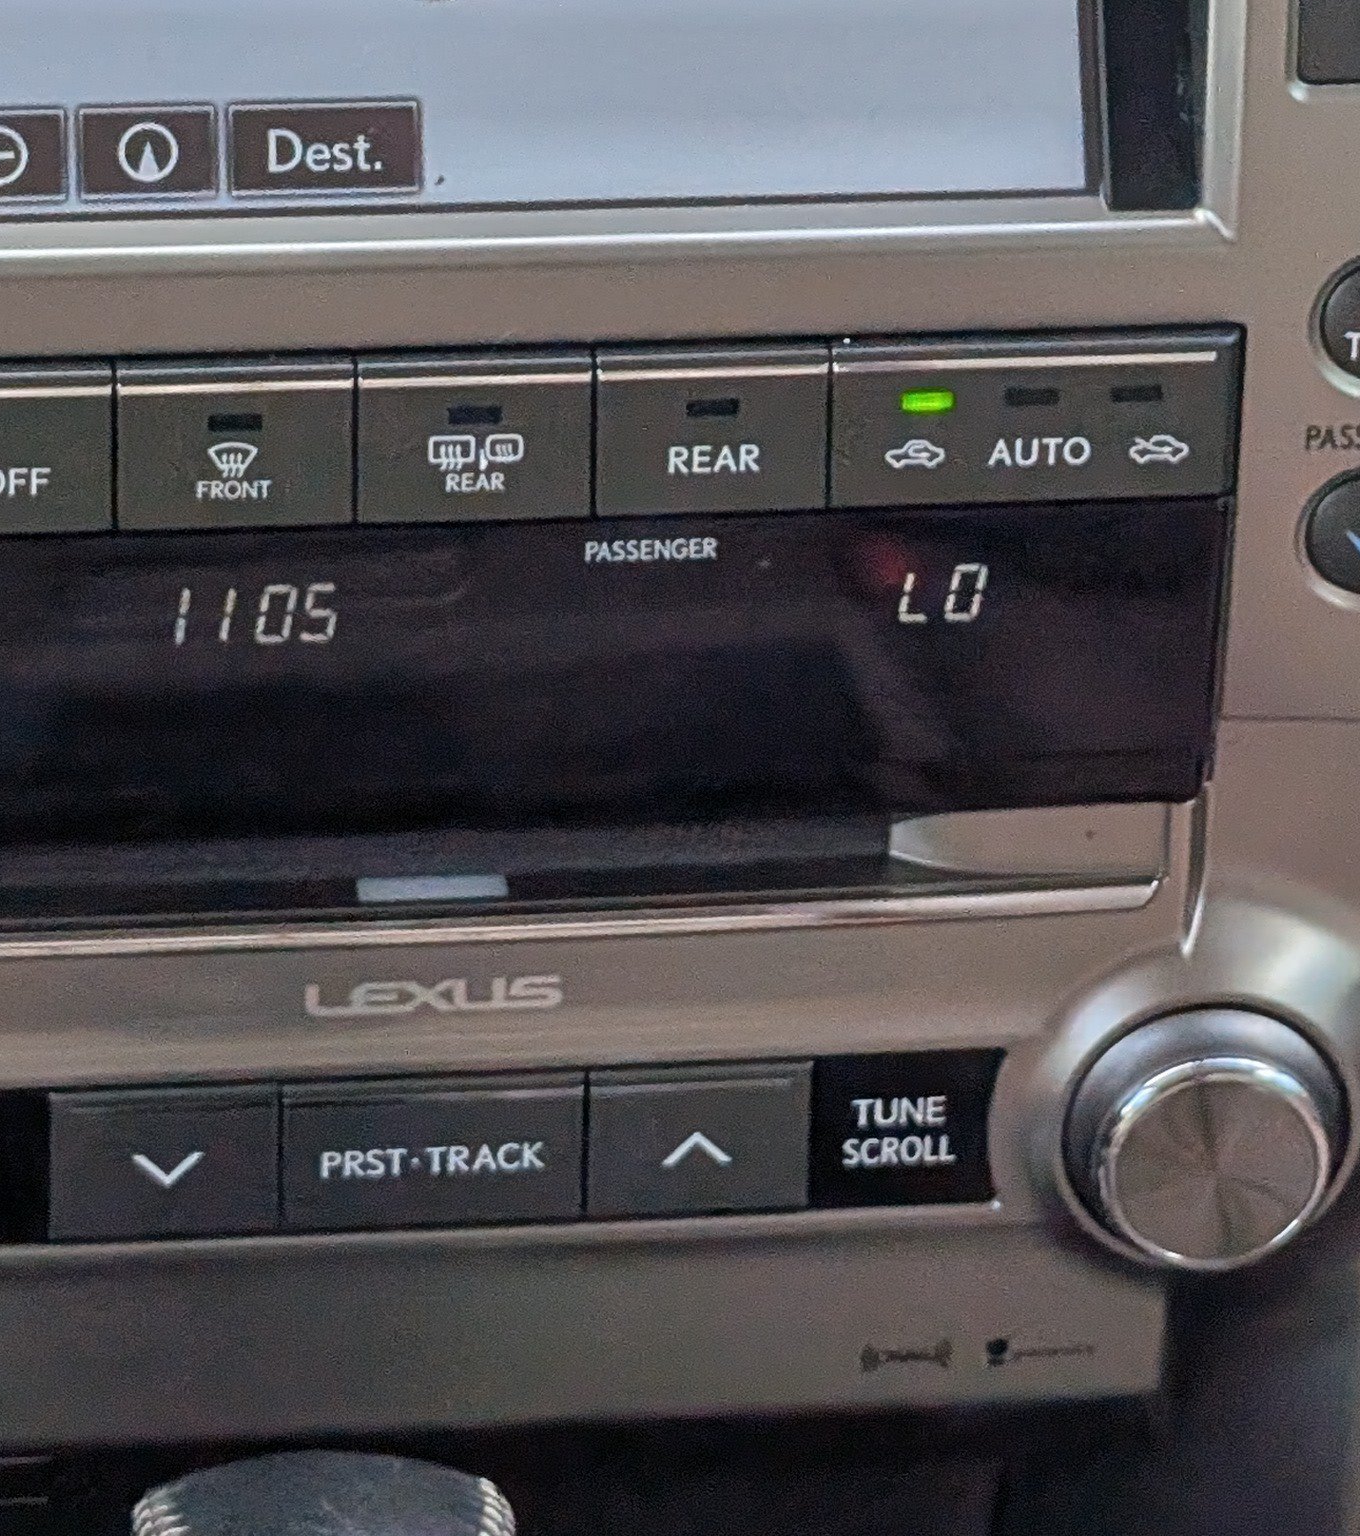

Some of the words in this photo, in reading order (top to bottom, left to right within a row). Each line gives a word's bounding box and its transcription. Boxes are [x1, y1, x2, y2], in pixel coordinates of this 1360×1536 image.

[267, 128, 382, 173] Dest.
[667, 444, 760, 474] REAR
[987, 436, 1091, 467] AUTO
[196, 479, 272, 500] FRONT
[445, 471, 505, 493] REAR
[584, 537, 718, 562] PASSENGER
[305, 974, 564, 1016] LEXUS
[852, 1095, 946, 1127] TUNE
[842, 1134, 956, 1167] SCROLL
